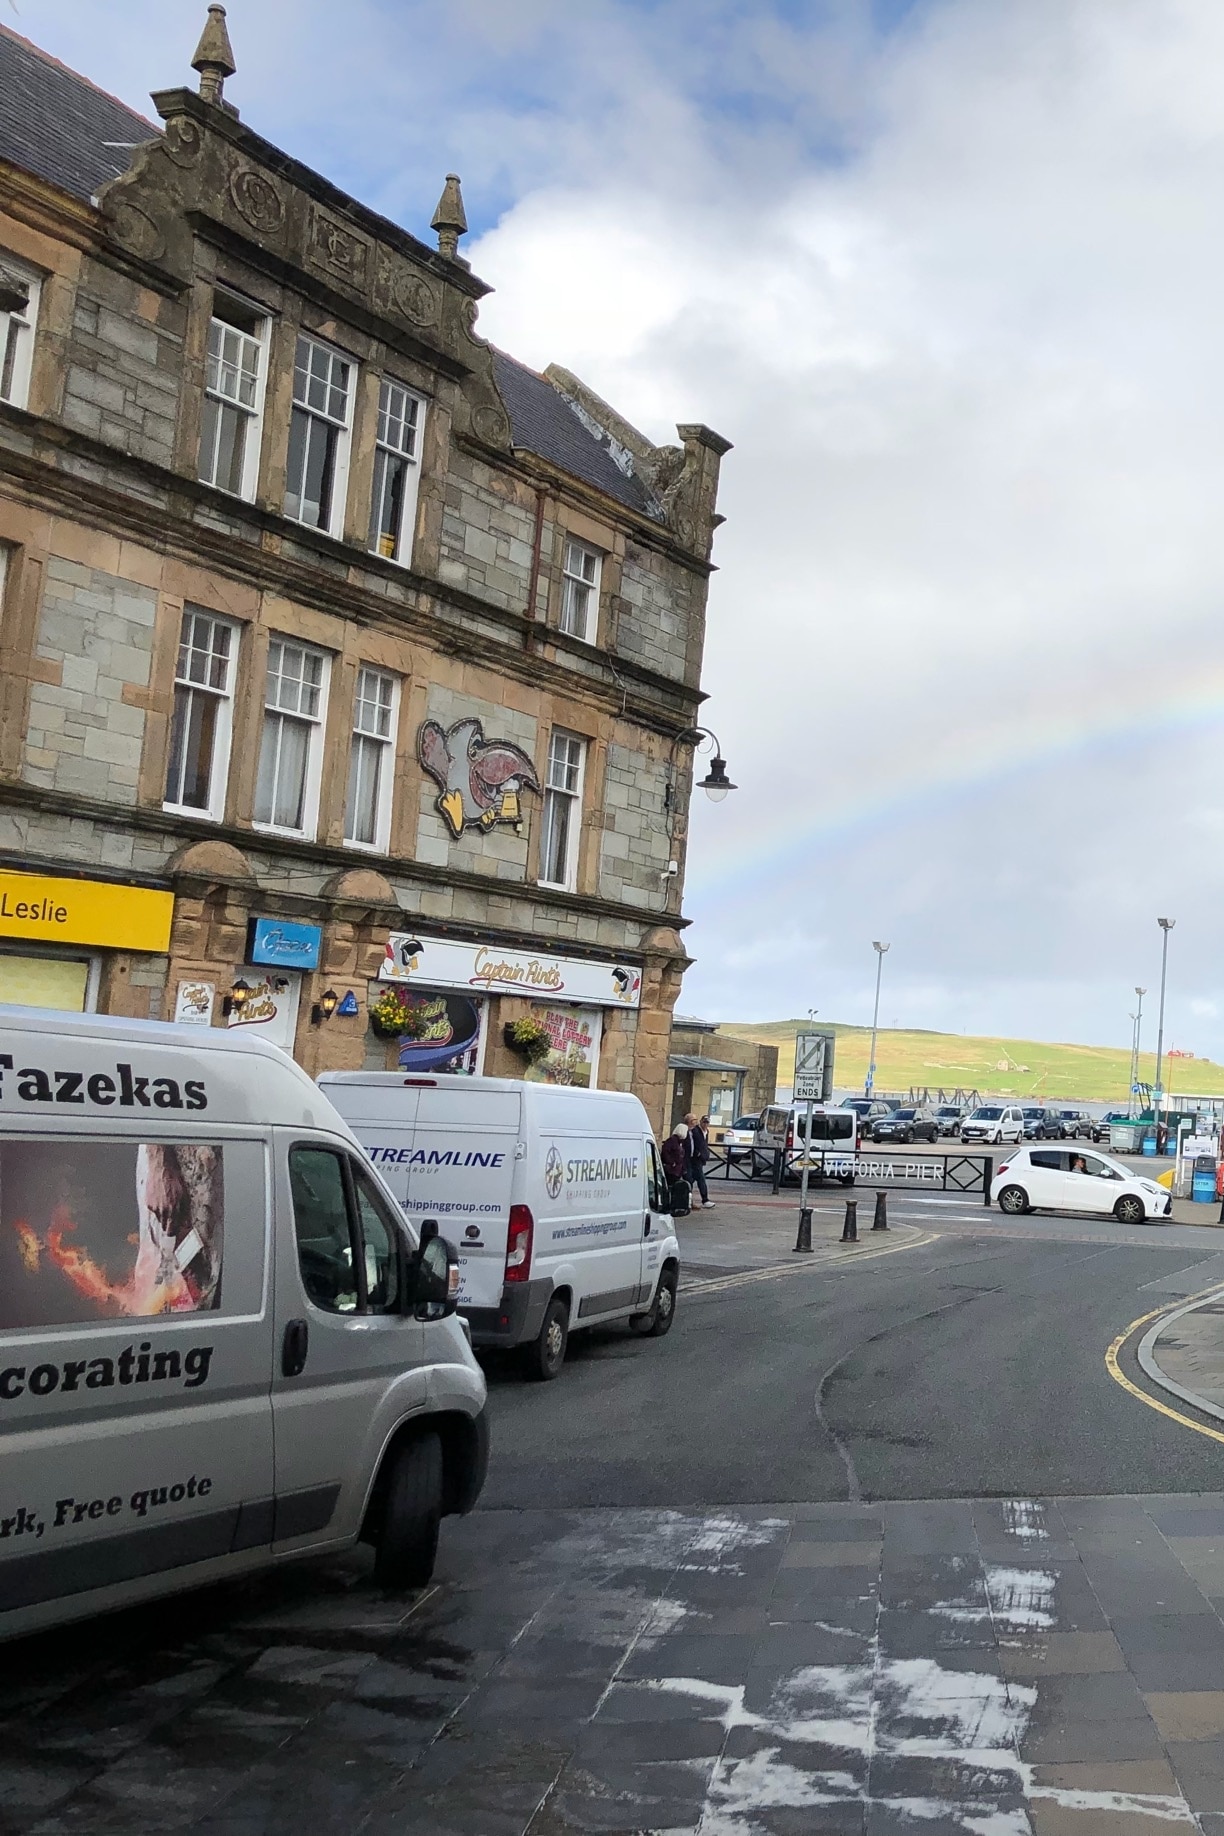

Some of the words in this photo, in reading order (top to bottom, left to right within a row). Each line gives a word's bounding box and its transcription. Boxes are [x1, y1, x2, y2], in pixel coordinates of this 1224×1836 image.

[1, 893, 68, 923] Leslie
[475, 947, 525, 989] Captain
[526, 960, 561, 987] Flint's
[546, 1011, 564, 1025] PLAY
[565, 1017, 579, 1030] THE
[797, 1088, 819, 1097] ENDS
[405, 1166, 440, 1174] GROUP
[567, 1158, 637, 1182] STREAMLINE
[824, 1159, 895, 1180] VICTORIA
[905, 1163, 945, 1181] PIER
[0, 1342, 214, 1399] corating
[53, 1498, 123, 1527] Free
[130, 1475, 212, 1517] quote
